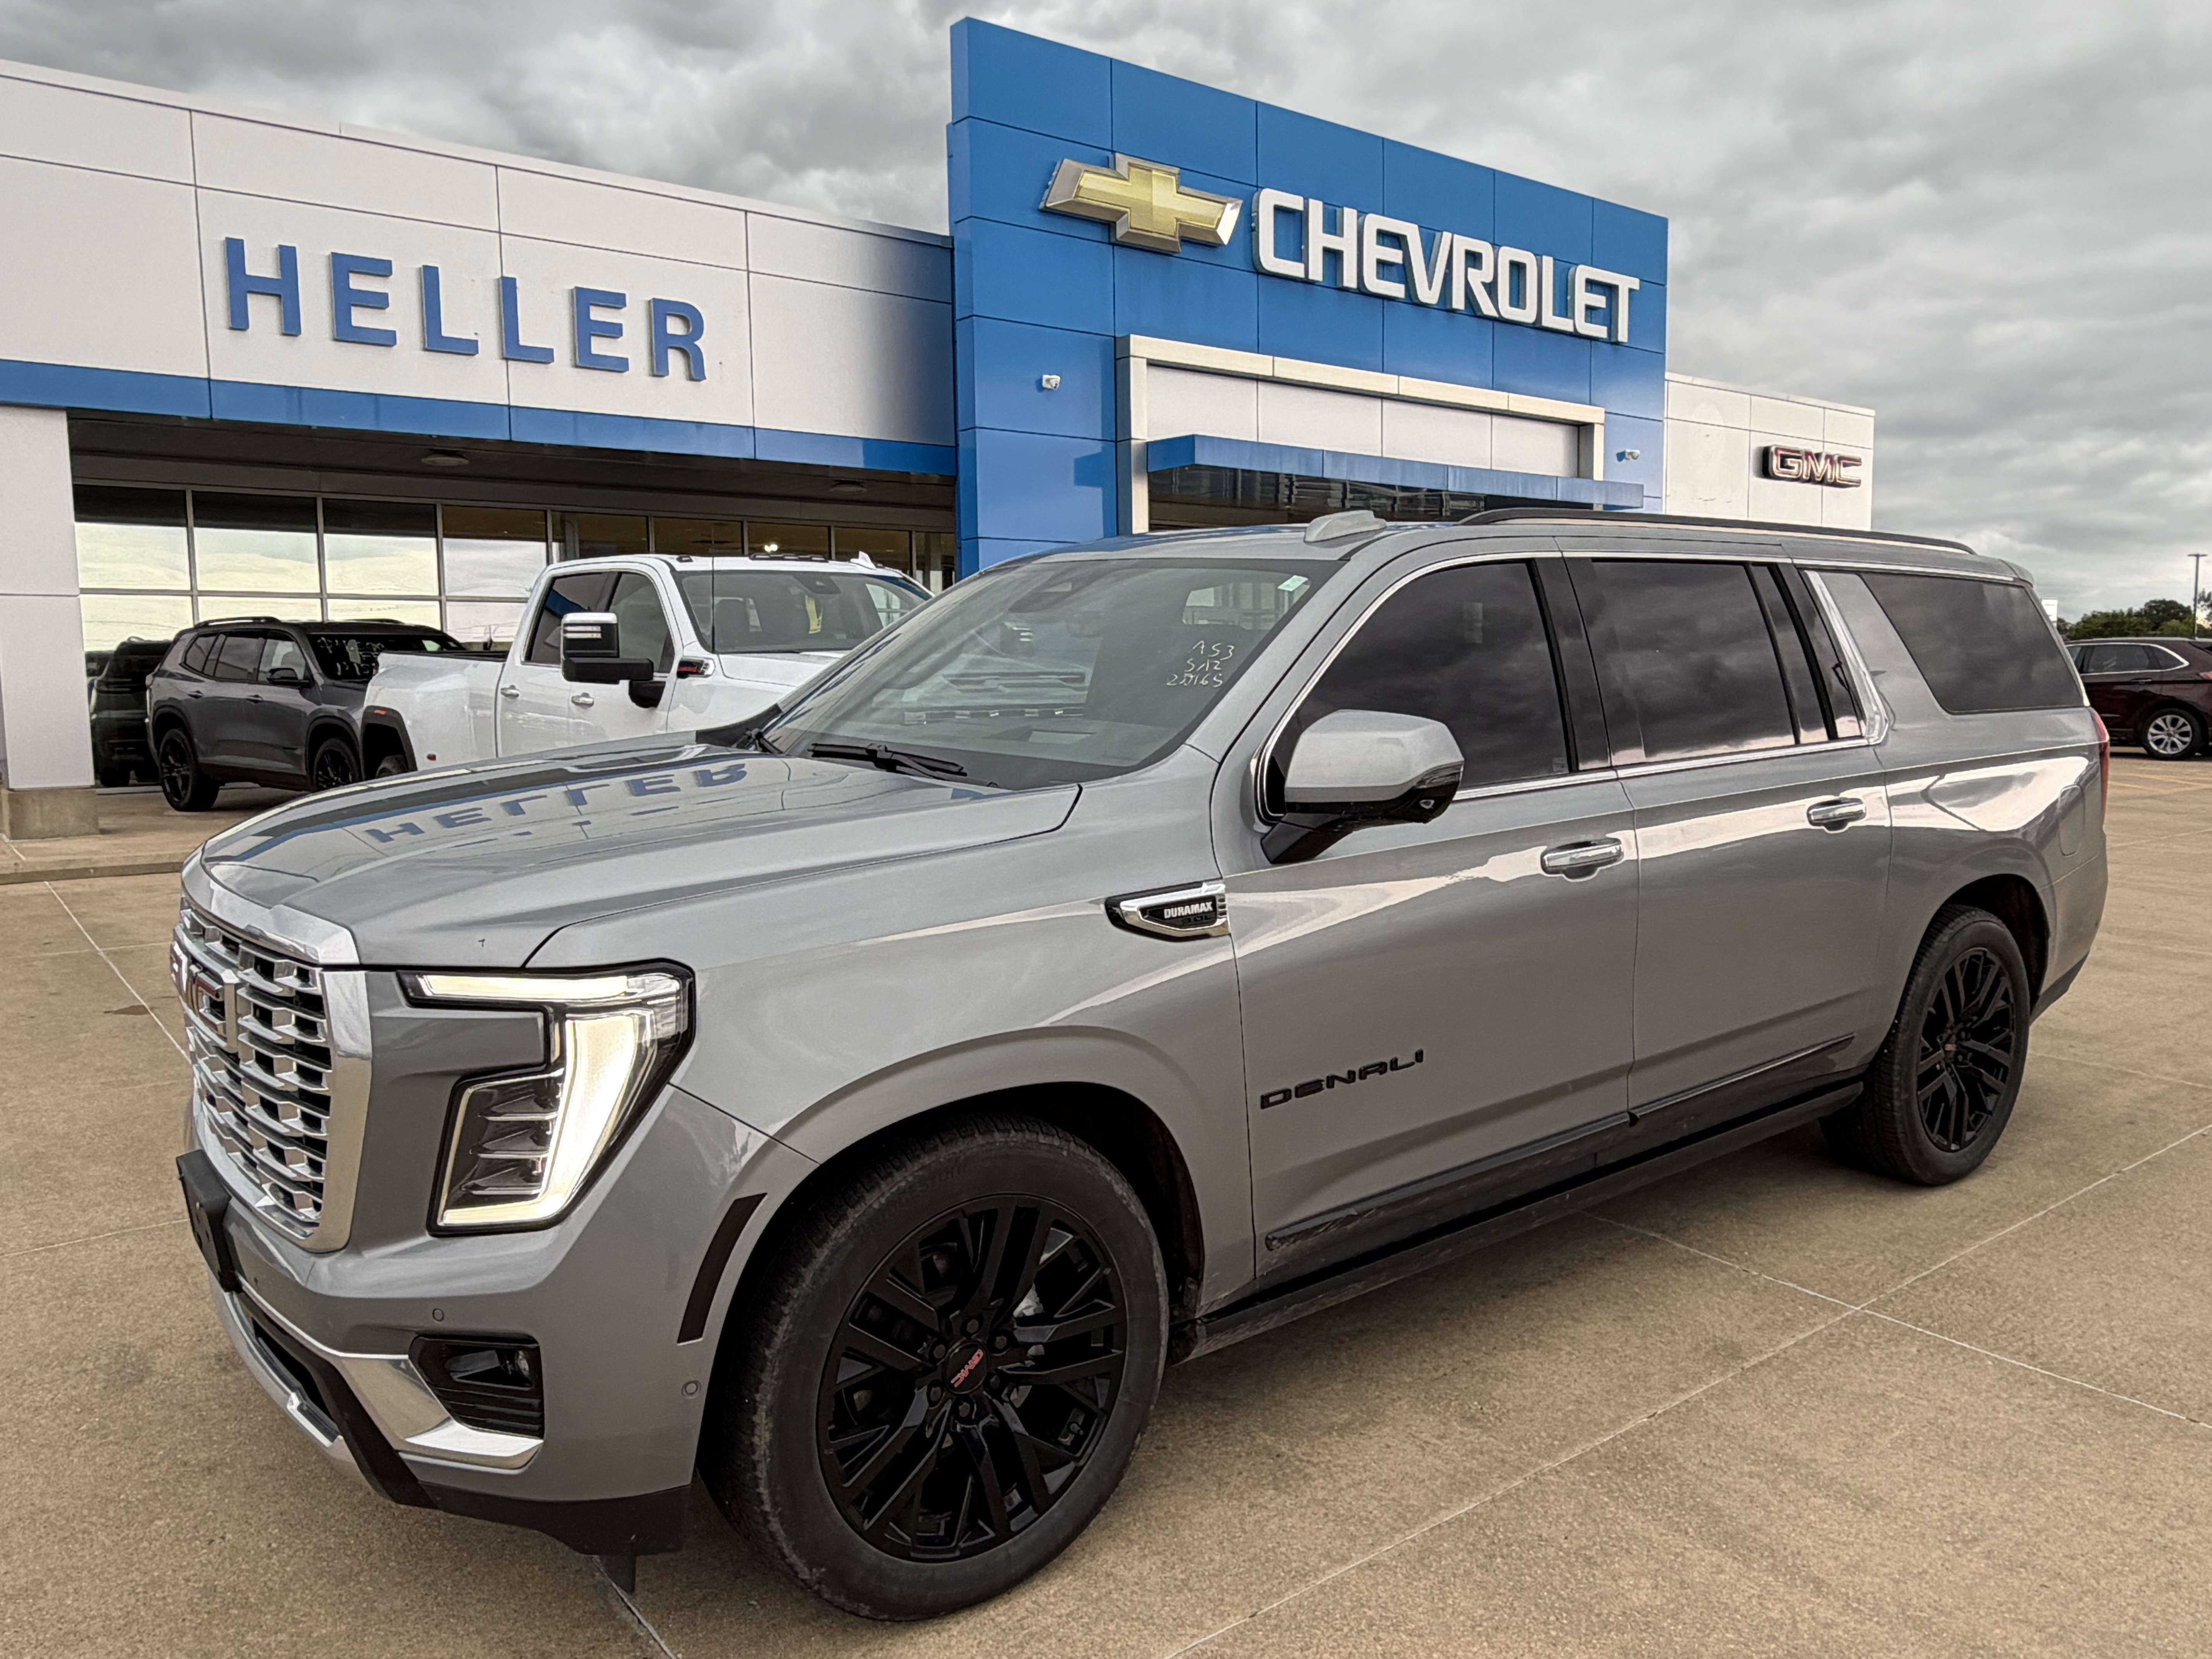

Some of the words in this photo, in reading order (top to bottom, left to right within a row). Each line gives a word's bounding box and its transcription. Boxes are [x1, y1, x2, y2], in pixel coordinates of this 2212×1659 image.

[1254, 188, 1640, 342] CHEVROLET
[225, 236, 707, 381] HELLER
[1767, 445, 1862, 487] GMC
[1163, 902, 1212, 919] DURAMAX
[1260, 1048, 1424, 1109] DENALI
